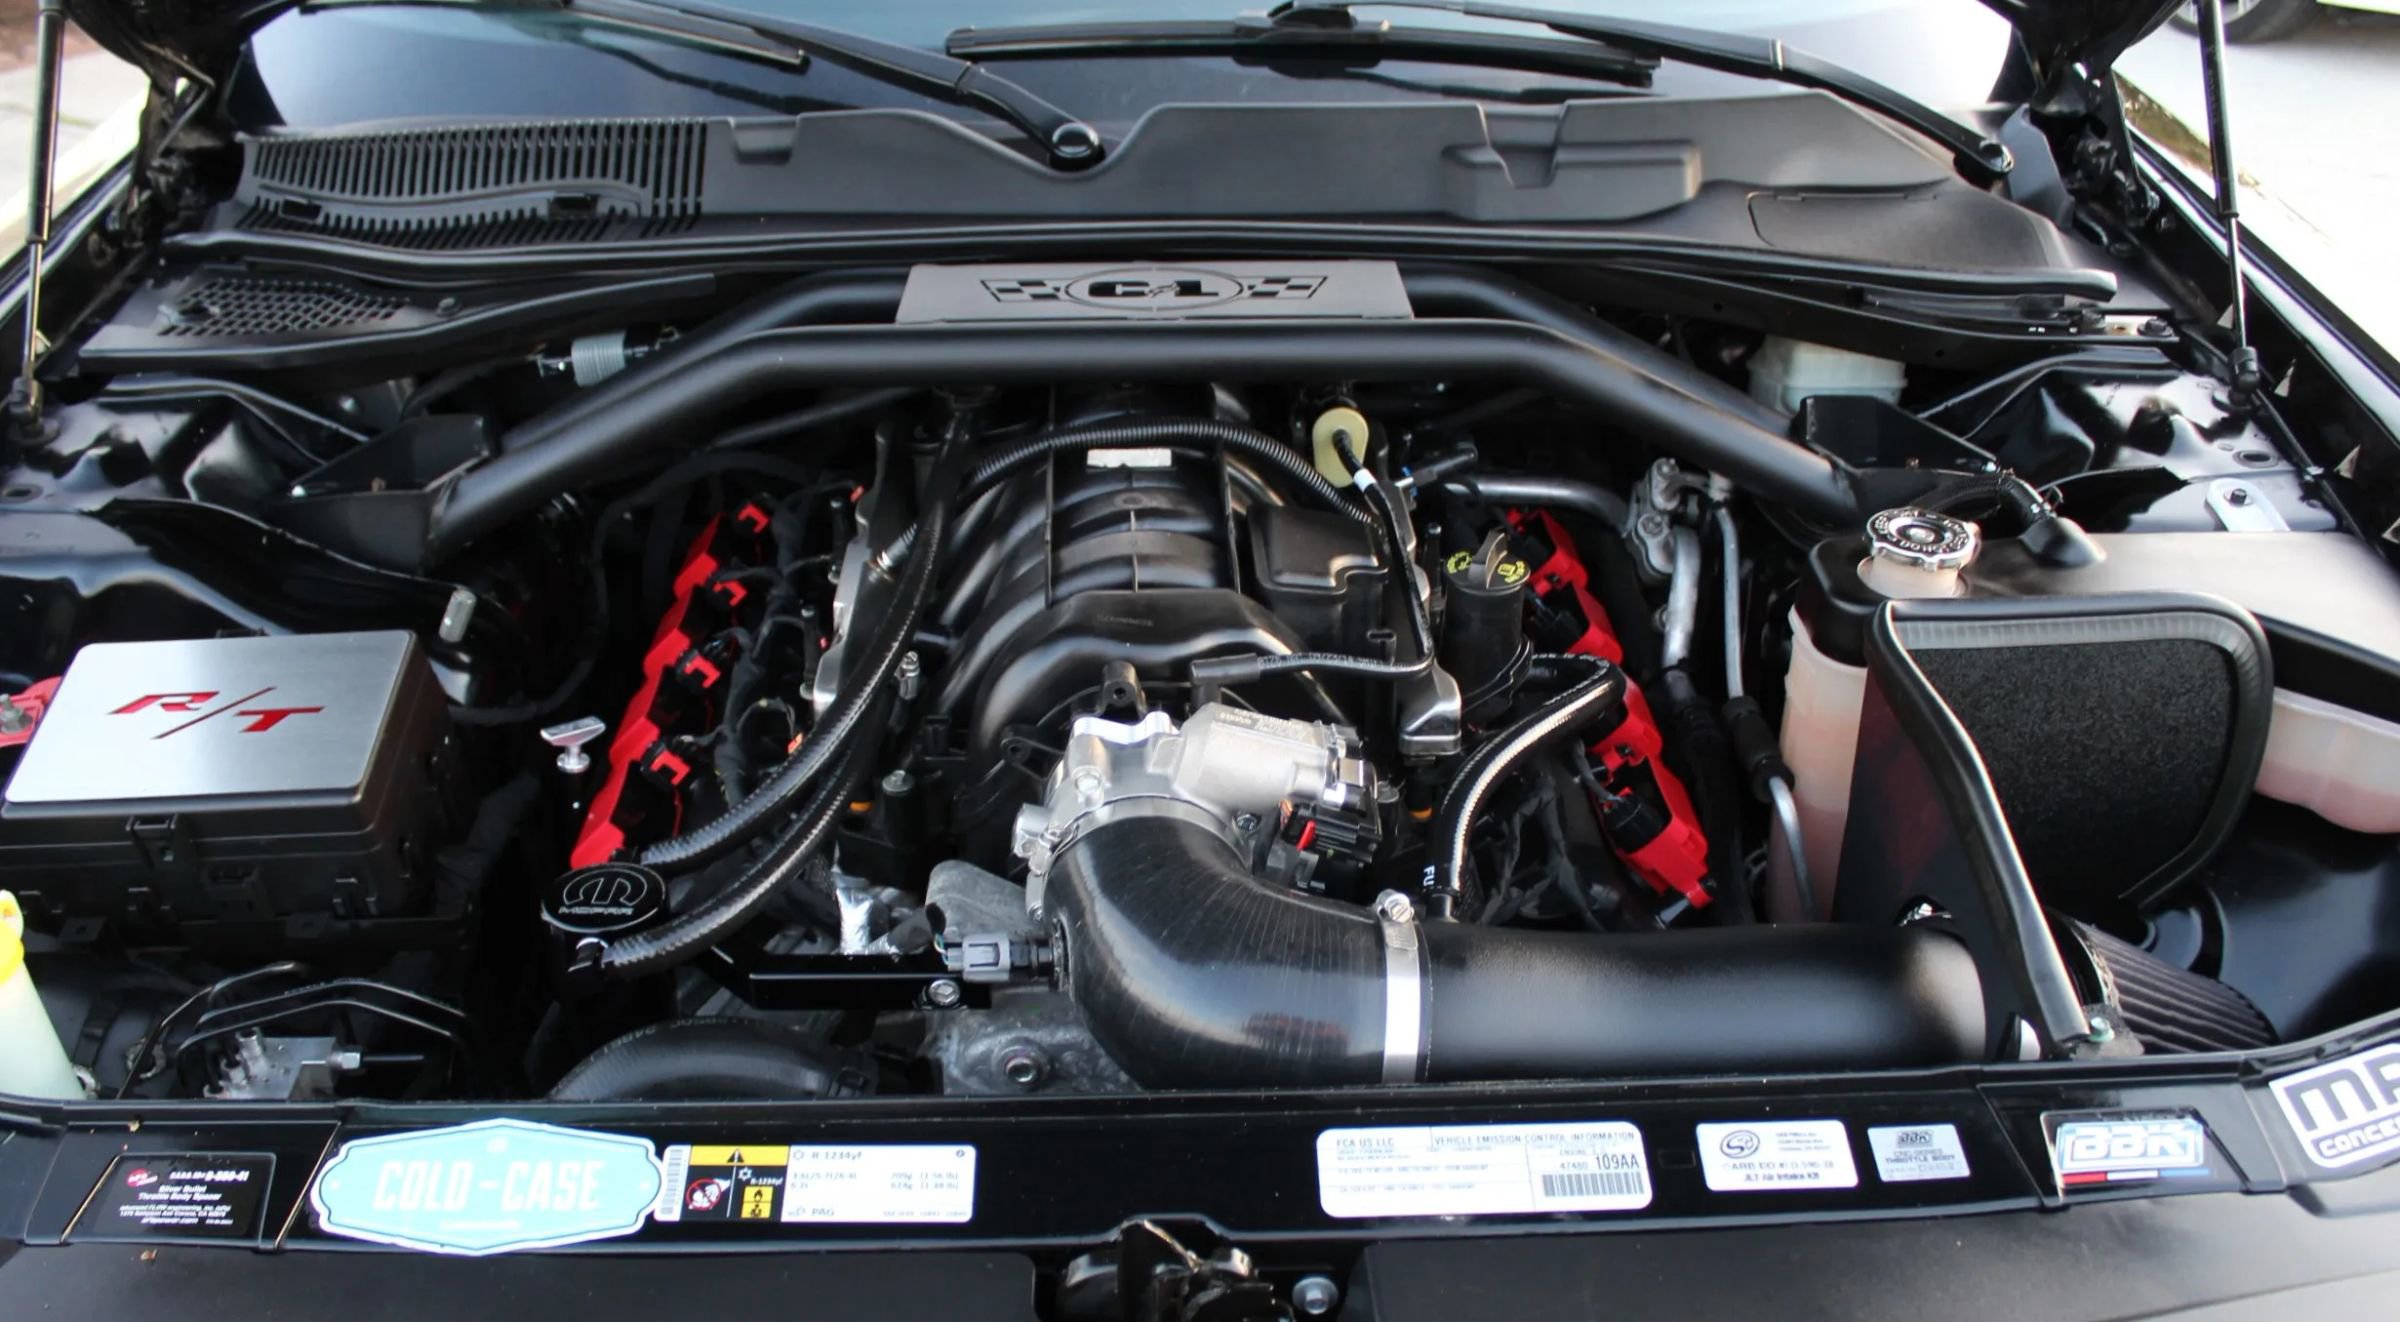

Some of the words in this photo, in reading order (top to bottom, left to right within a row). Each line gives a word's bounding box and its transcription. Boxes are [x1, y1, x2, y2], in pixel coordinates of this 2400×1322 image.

[108, 687, 326, 739] R/T
[558, 906, 634, 916] MOPAR
[1336, 1138, 1355, 1147] FCA
[1359, 1138, 1372, 1147] US
[1434, 1136, 1472, 1145] VEHICLE
[1476, 1134, 1521, 1144] EMISSION
[1525, 1133, 1566, 1143] CONTROL
[1570, 1132, 1635, 1141] INFORMATION
[2071, 1124, 2188, 1161] BBK
[1596, 1153, 1640, 1170] 109AA
[139, 1192, 170, 1201] Throttle
[170, 1192, 192, 1202] Body
[192, 1193, 222, 1202] Spacer
[812, 1208, 835, 1217] PAG
